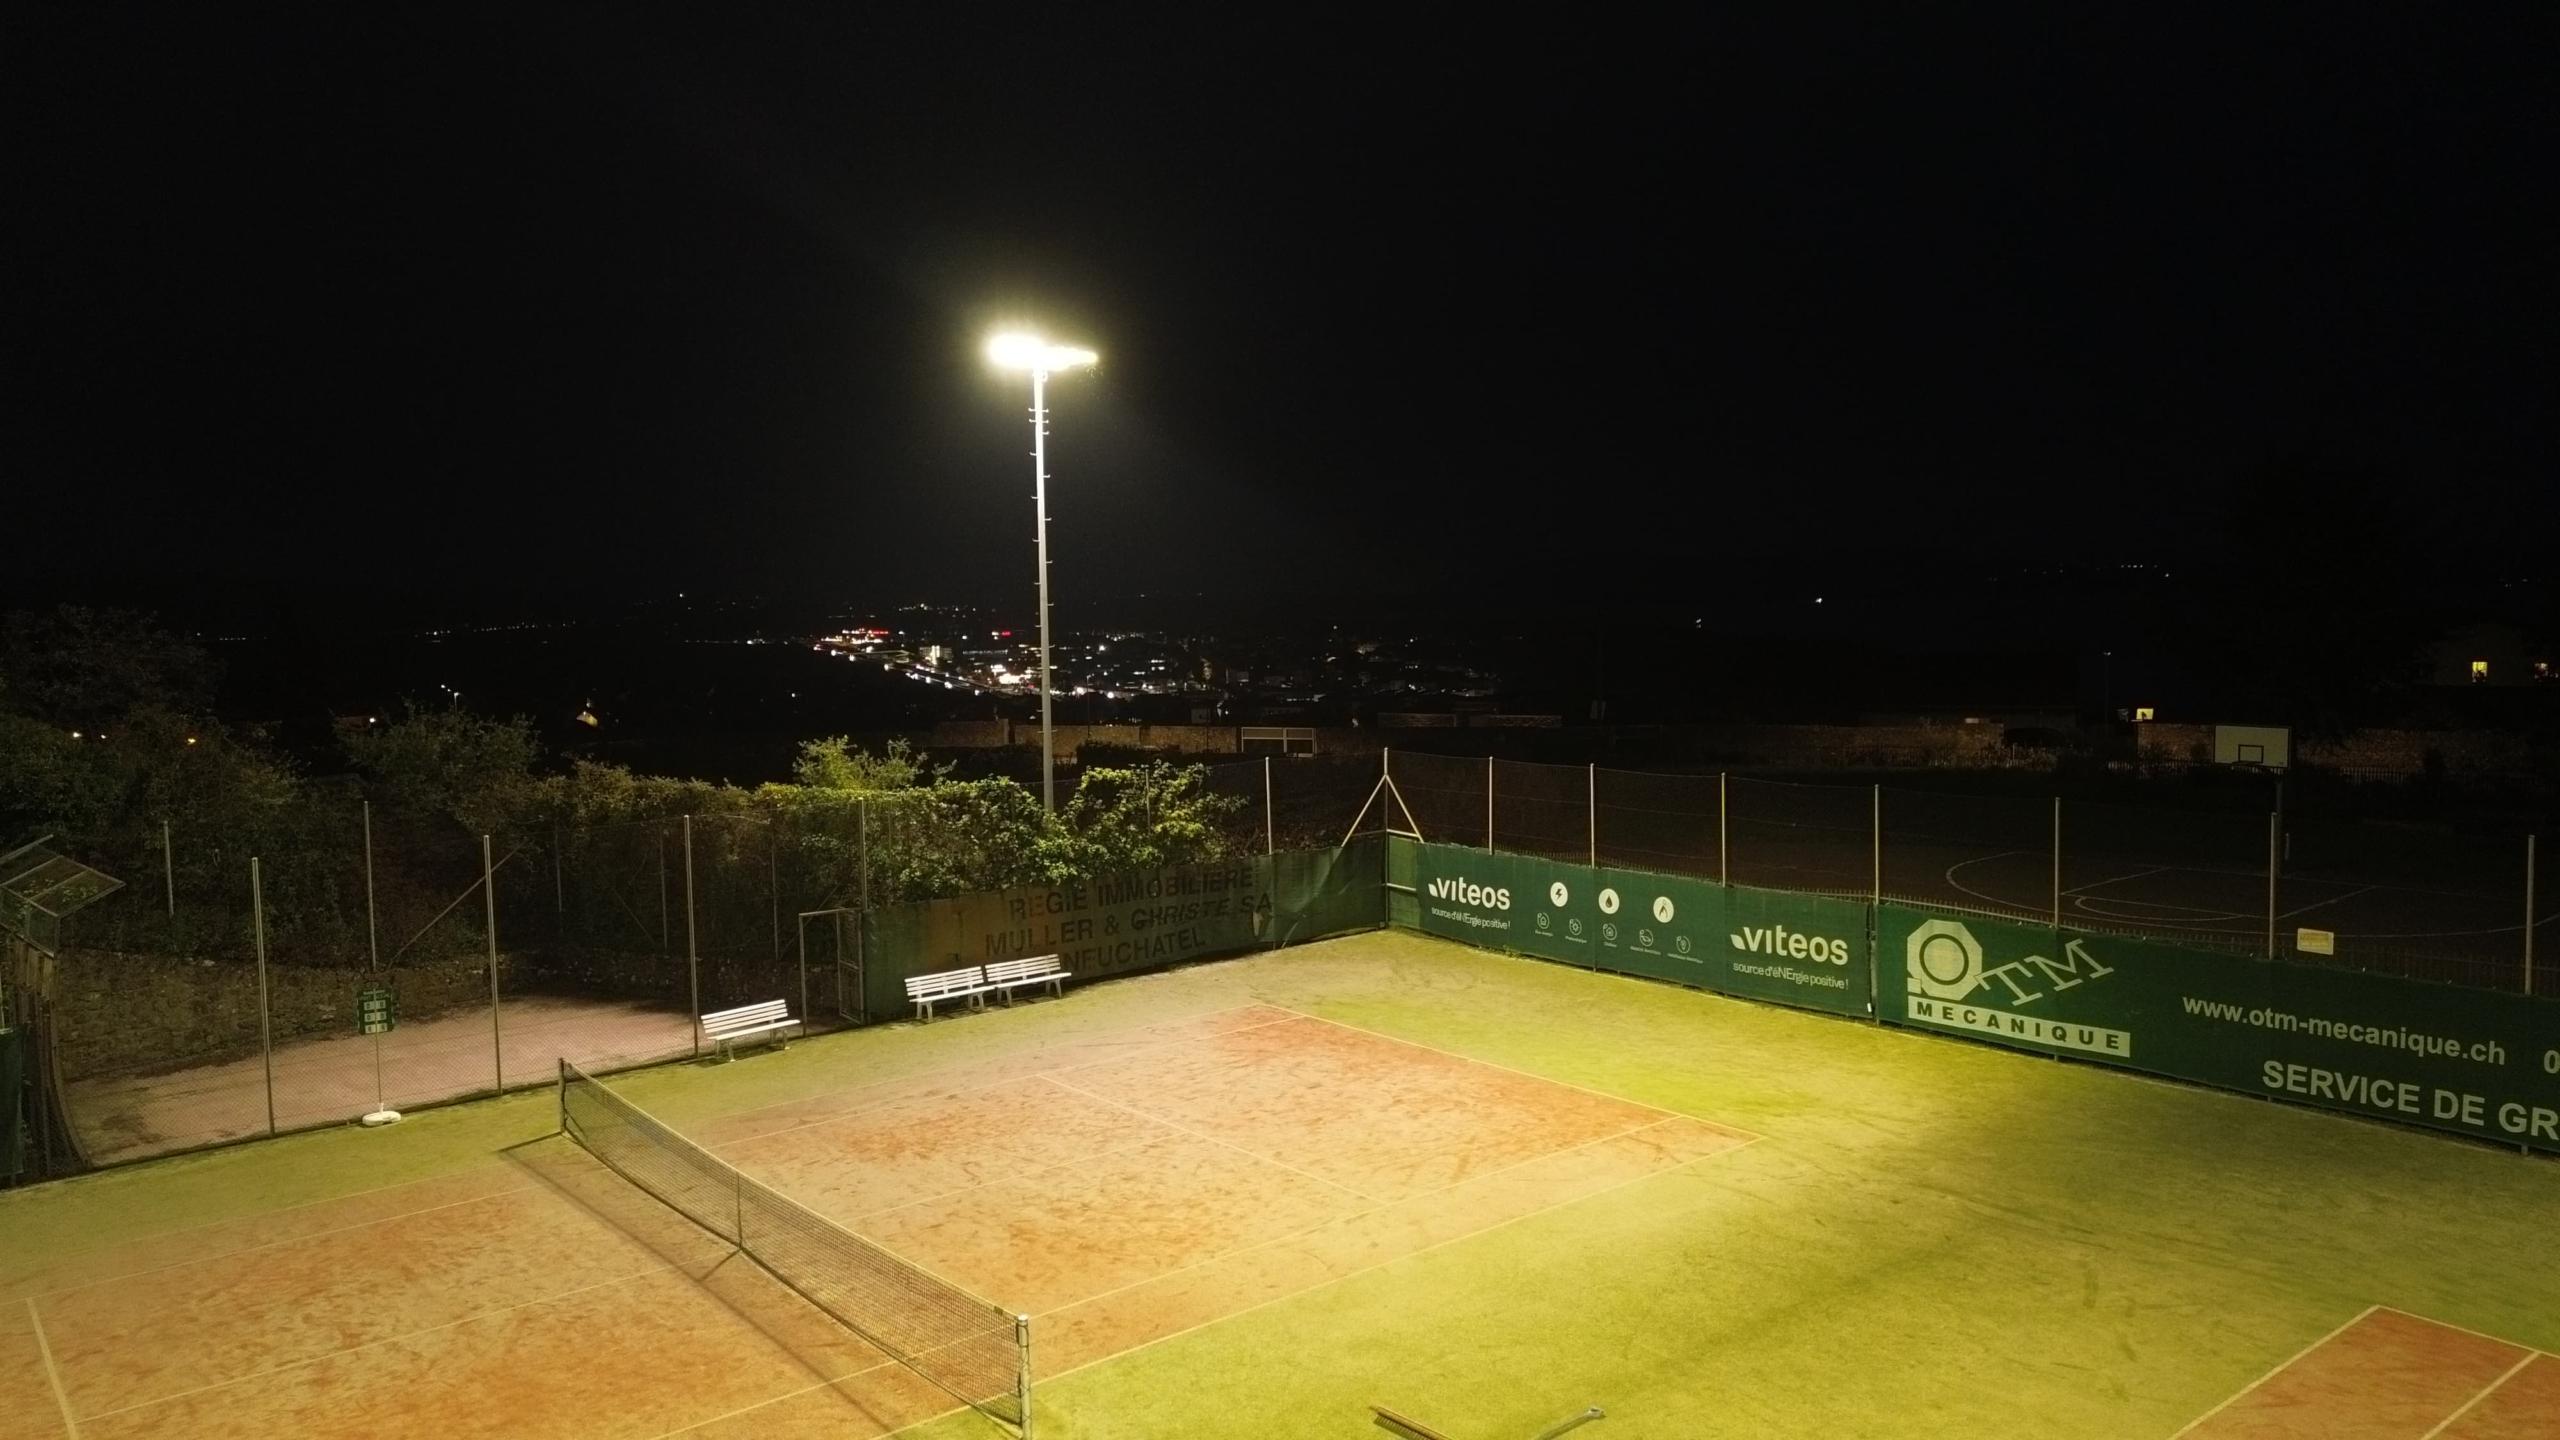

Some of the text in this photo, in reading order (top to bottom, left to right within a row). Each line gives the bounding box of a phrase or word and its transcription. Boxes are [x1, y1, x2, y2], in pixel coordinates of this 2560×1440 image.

[1104, 914, 1120, 936] &
[1239, 893, 1272, 914] SA
[1436, 877, 1511, 910] viteos
[1743, 925, 1848, 965] viteos
[1733, 962, 1764, 976] source
[1810, 975, 1844, 989] positive
[1917, 1001, 2119, 1050] MECANIQUE
[2182, 996, 2506, 1066] www.otm-mecanique.ch
[2262, 1060, 2420, 1114] SERVICE
[2433, 1089, 2486, 1126] DE
